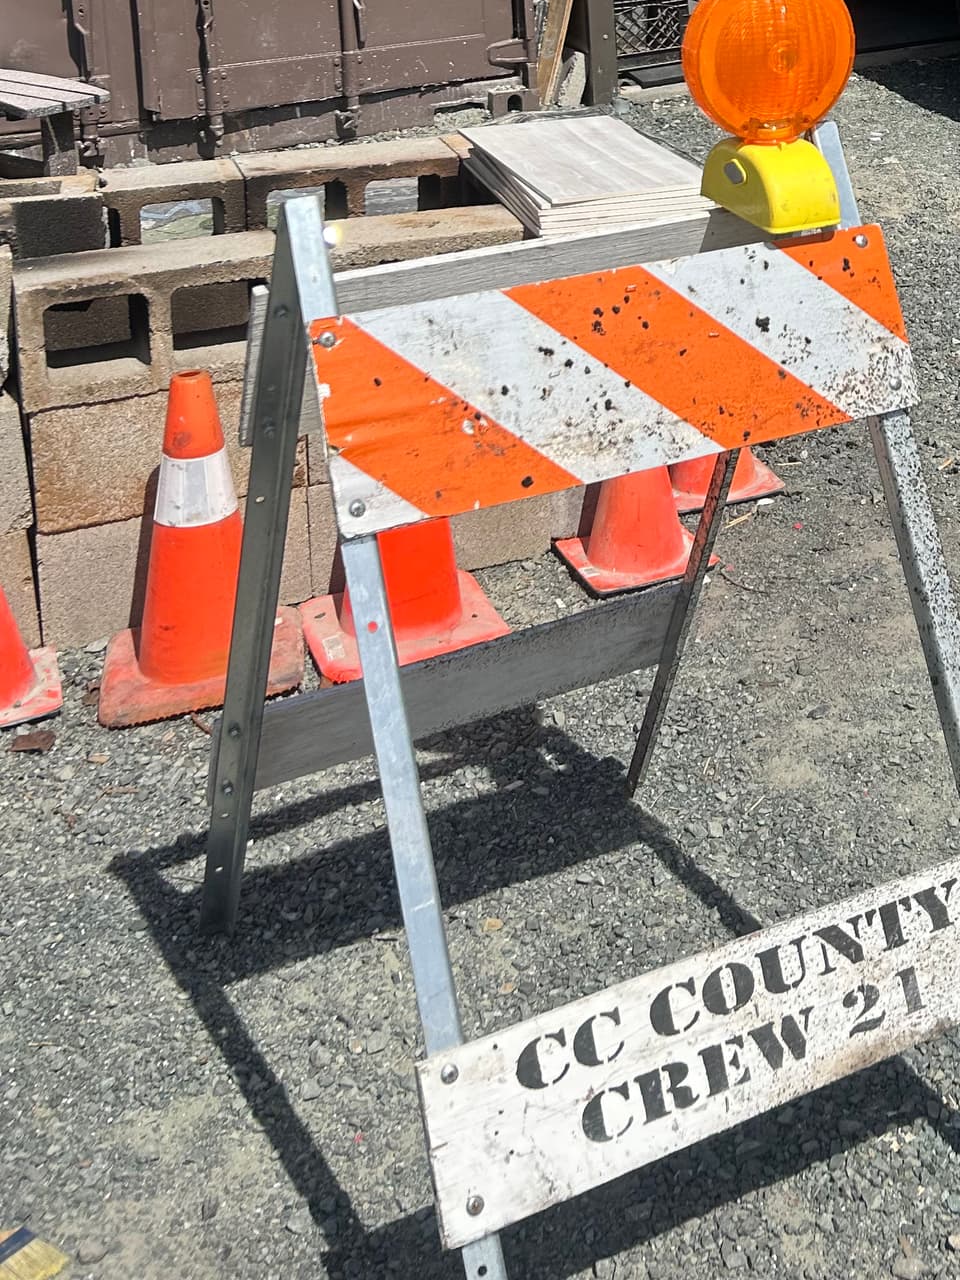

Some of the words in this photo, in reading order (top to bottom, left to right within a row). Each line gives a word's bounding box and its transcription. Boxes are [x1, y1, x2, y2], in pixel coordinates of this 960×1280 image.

[515, 1005, 624, 1090] CC
[649, 877, 958, 1037] COUNTY
[580, 1005, 816, 1144] CREW
[844, 966, 926, 1037] 21
